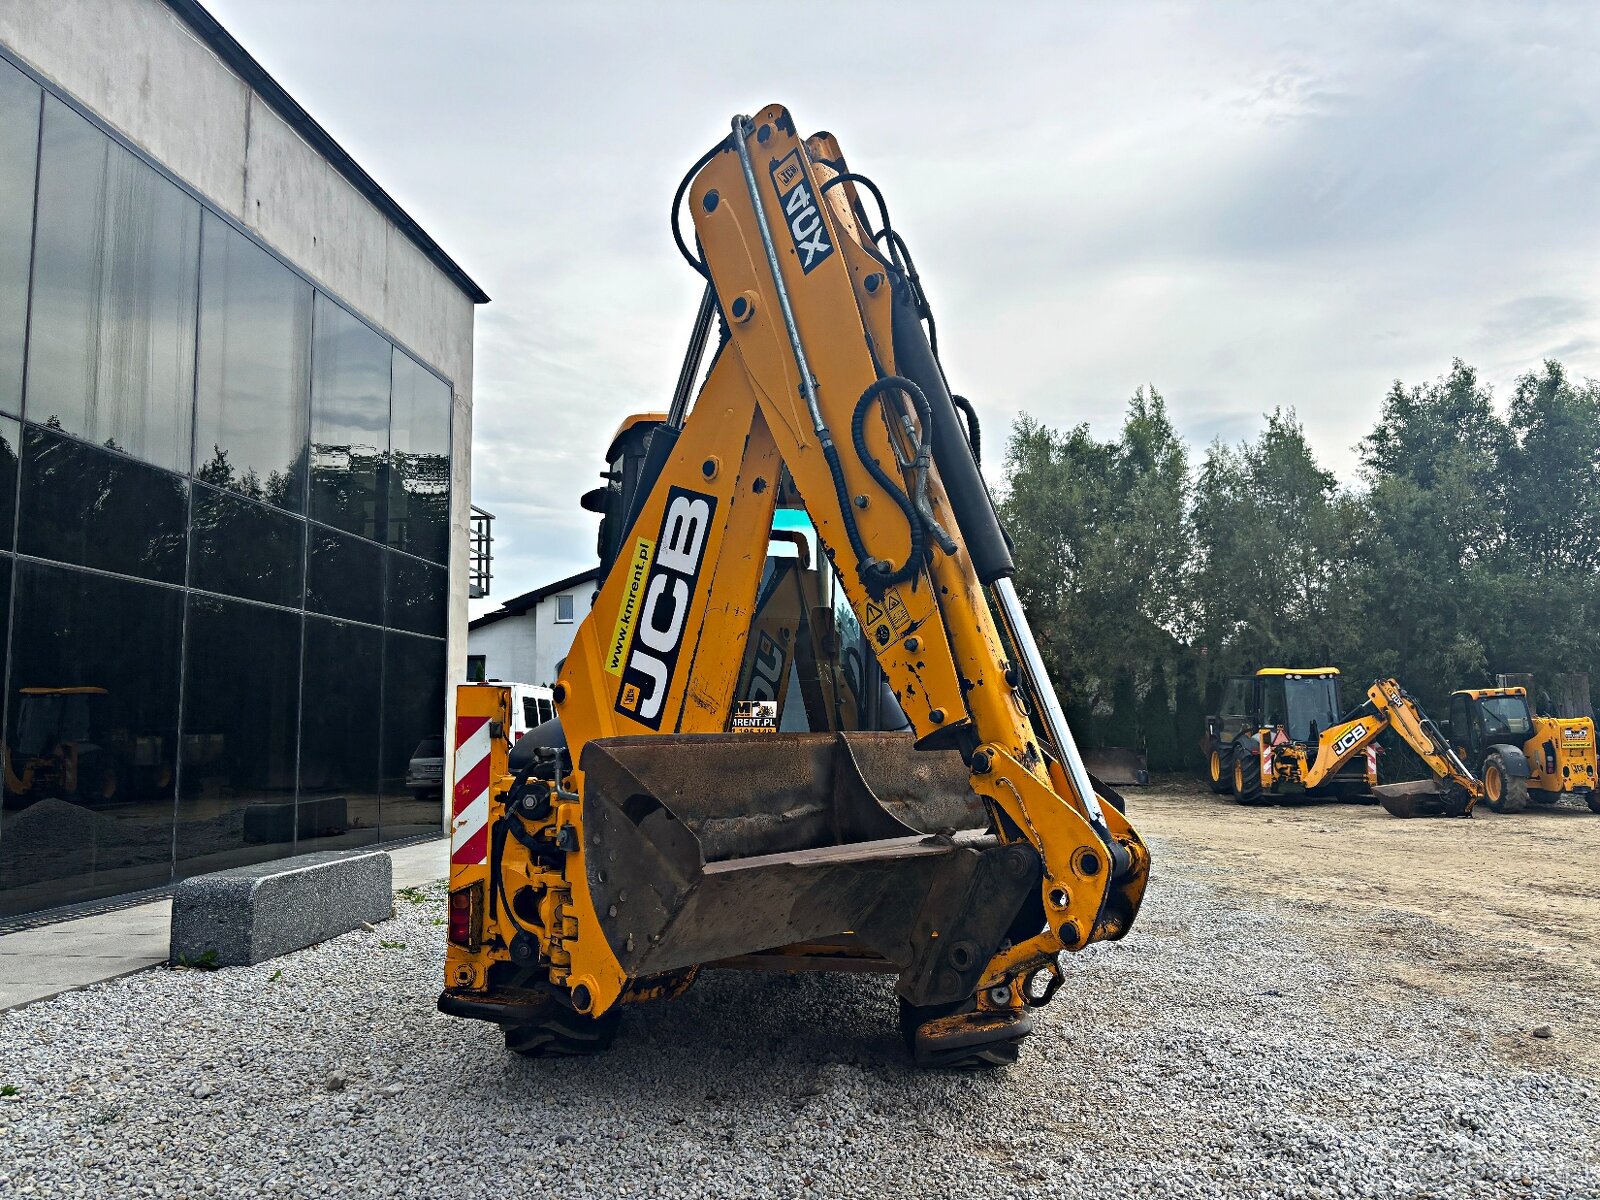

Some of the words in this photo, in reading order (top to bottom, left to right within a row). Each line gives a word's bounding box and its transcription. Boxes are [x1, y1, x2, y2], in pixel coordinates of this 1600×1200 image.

[786, 184, 831, 268] 4CX
[611, 543, 649, 669] www.kmrent.pl
[630, 496, 710, 719] JCB
[1335, 724, 1366, 755] JCB
